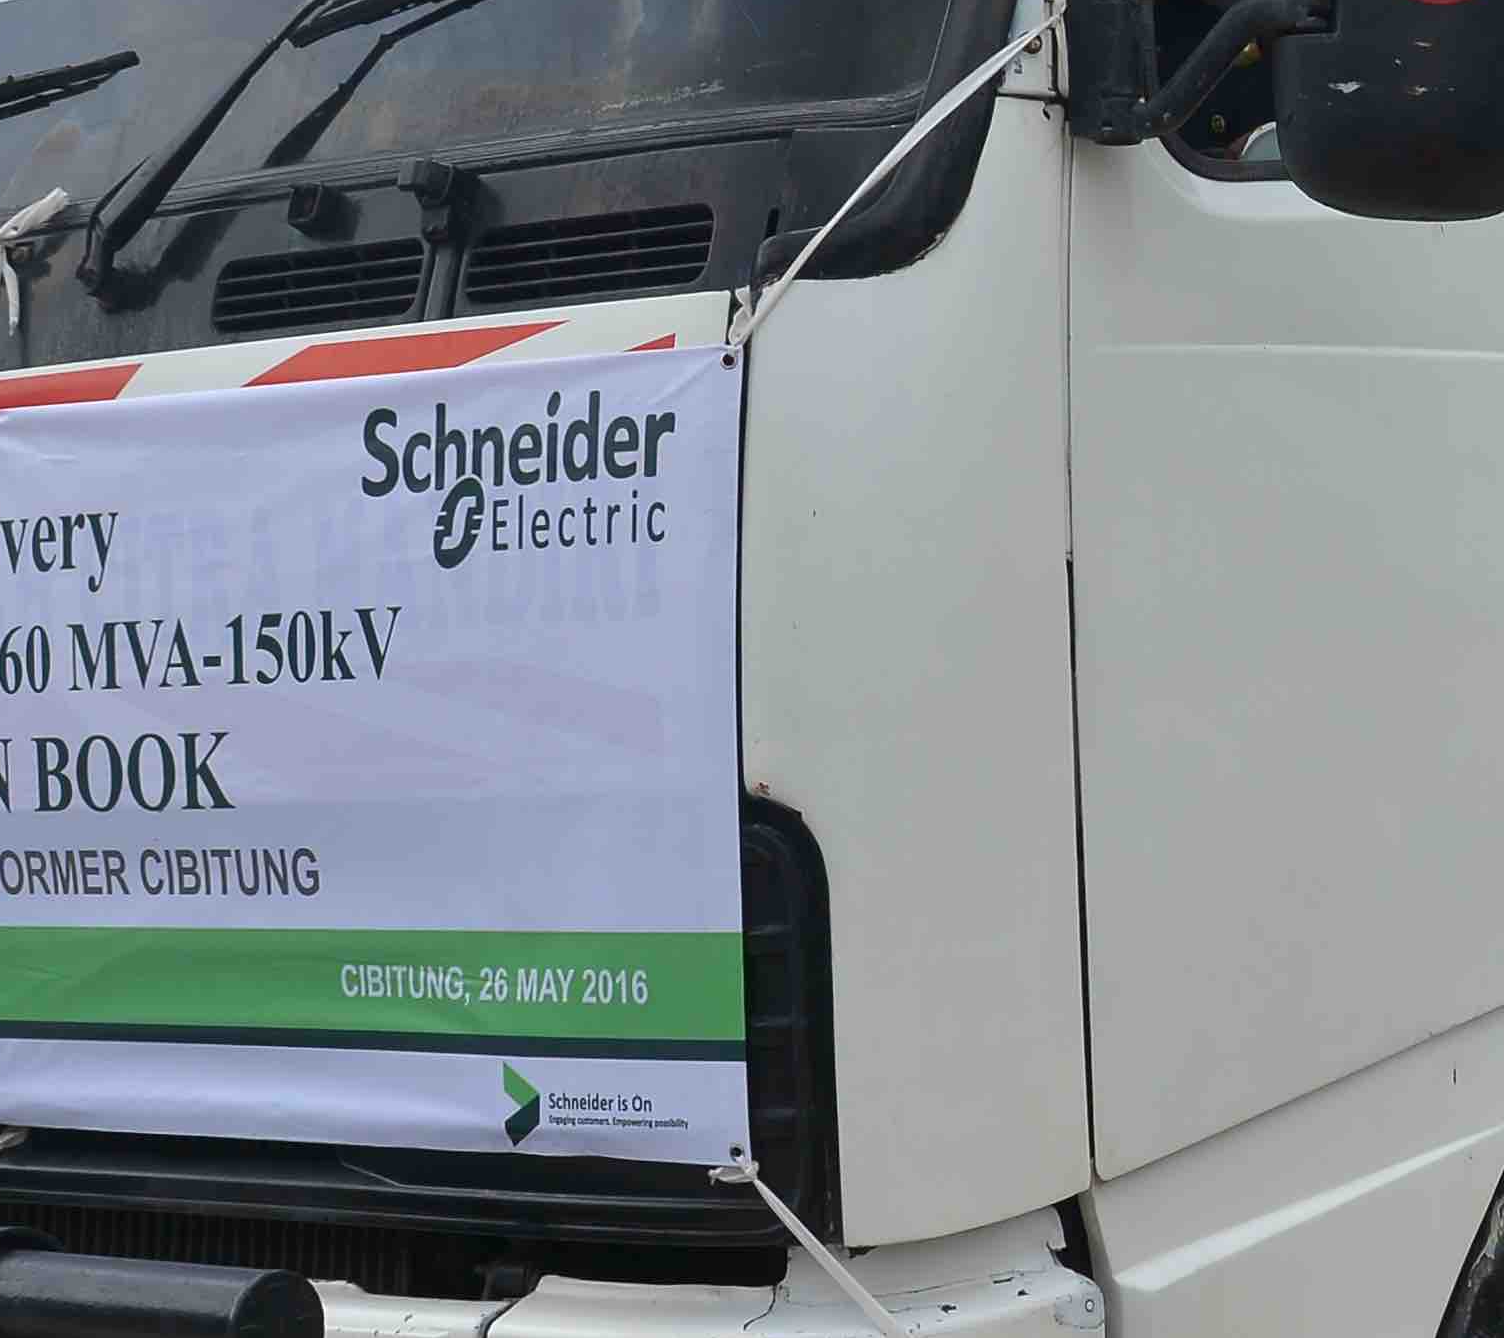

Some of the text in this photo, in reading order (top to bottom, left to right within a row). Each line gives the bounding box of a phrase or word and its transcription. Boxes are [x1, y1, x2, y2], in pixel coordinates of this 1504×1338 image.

[361, 390, 676, 497] Schneider
[493, 489, 666, 551] Electric
[68, 606, 403, 693] MVA-150kV
[36, 731, 236, 815] BOOK
[139, 848, 321, 897] CIBITUNG
[341, 964, 649, 1005] CIBITUNG, 26 MAY 2016
[548, 1092, 653, 1112] Schneider is On
